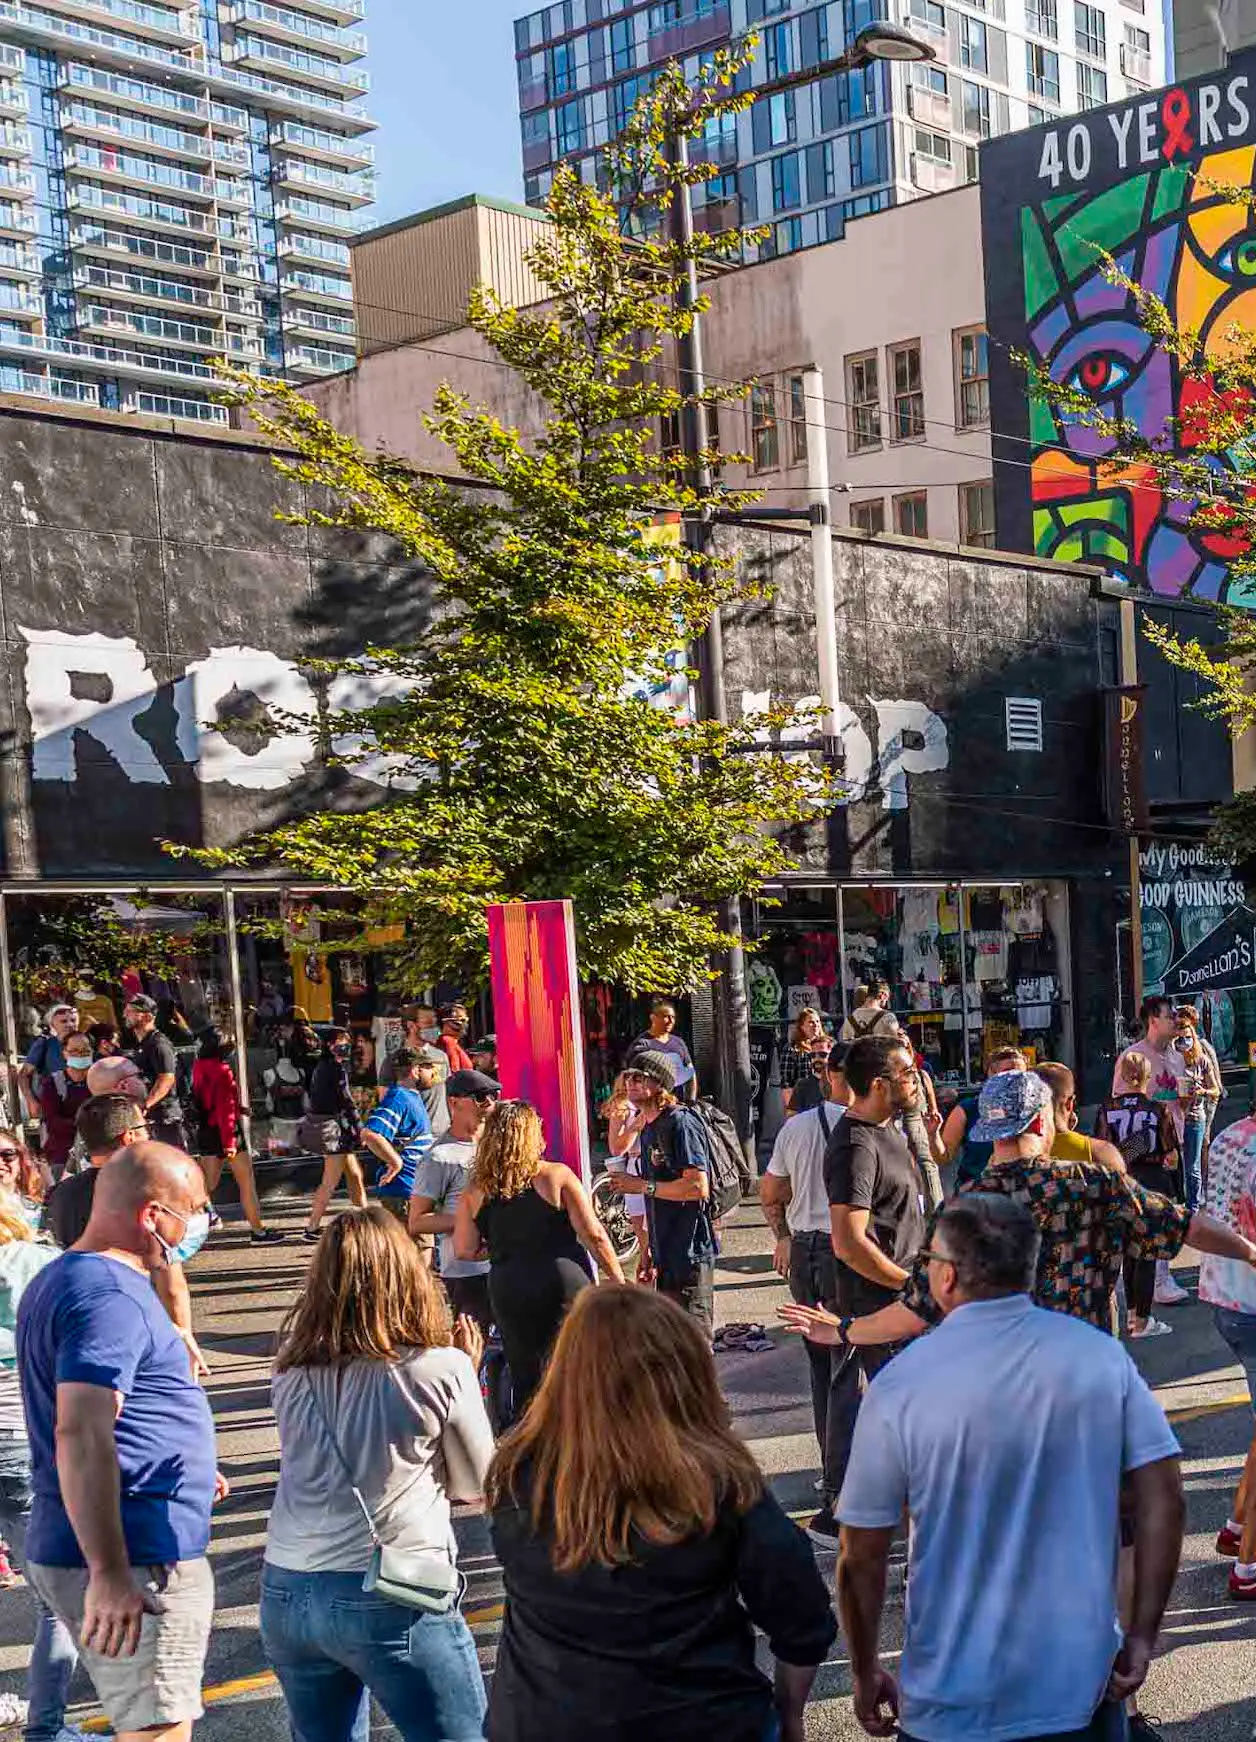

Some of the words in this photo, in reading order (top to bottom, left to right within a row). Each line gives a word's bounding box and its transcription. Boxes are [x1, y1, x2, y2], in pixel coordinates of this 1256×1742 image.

[1038, 124, 1091, 187] 40
[17, 624, 455, 792] ROC
[1138, 842, 1165, 877] My
[1169, 842, 1242, 870] Good
[1174, 880, 1246, 908] GUINNESS
[1142, 922, 1163, 933] ESON
